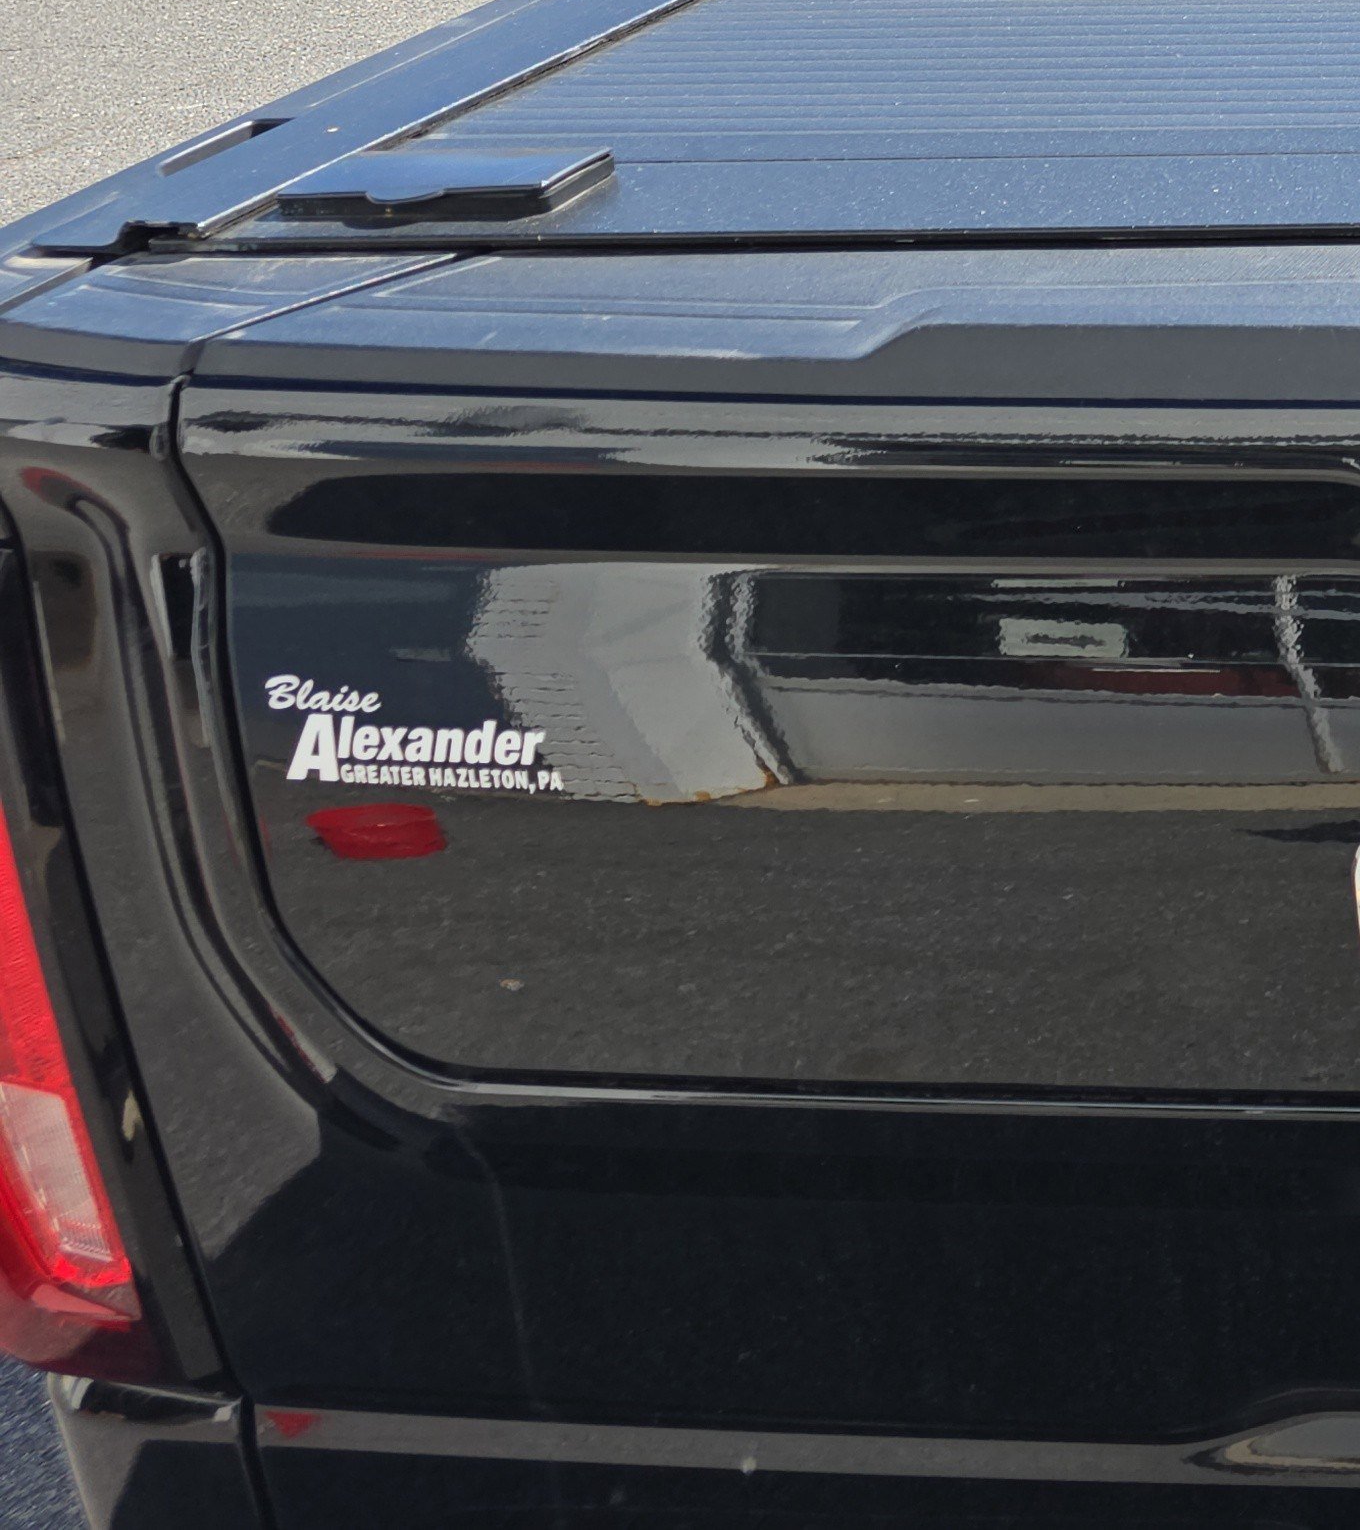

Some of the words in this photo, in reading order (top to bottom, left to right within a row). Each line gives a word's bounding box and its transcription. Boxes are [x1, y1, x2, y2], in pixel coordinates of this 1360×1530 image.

[264, 673, 382, 714] Blaise
[286, 713, 547, 783] Alexander
[339, 764, 426, 787] GREATER
[428, 767, 536, 795] HAZLETON,
[538, 771, 564, 792] PA
